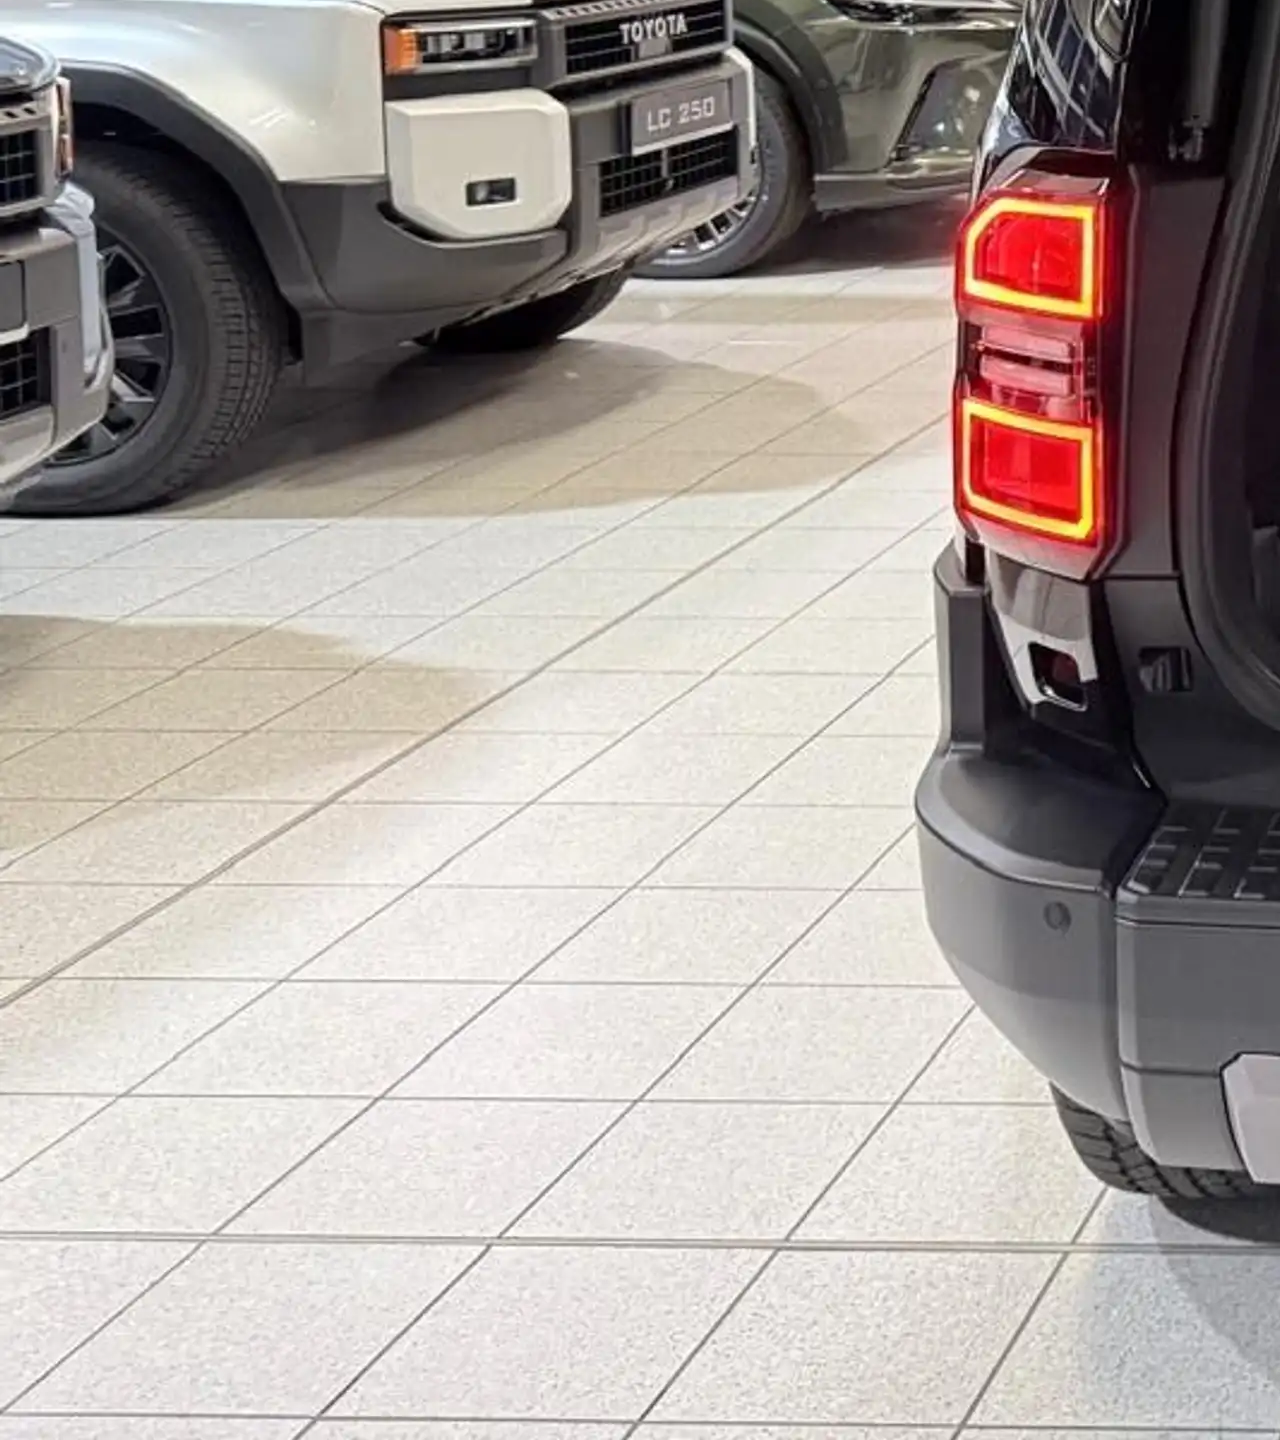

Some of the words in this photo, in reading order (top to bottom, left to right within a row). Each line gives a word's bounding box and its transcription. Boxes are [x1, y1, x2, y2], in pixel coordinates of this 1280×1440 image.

[619, 13, 688, 45] TOYOTA
[647, 108, 671, 131] LC
[678, 96, 715, 123] 250
